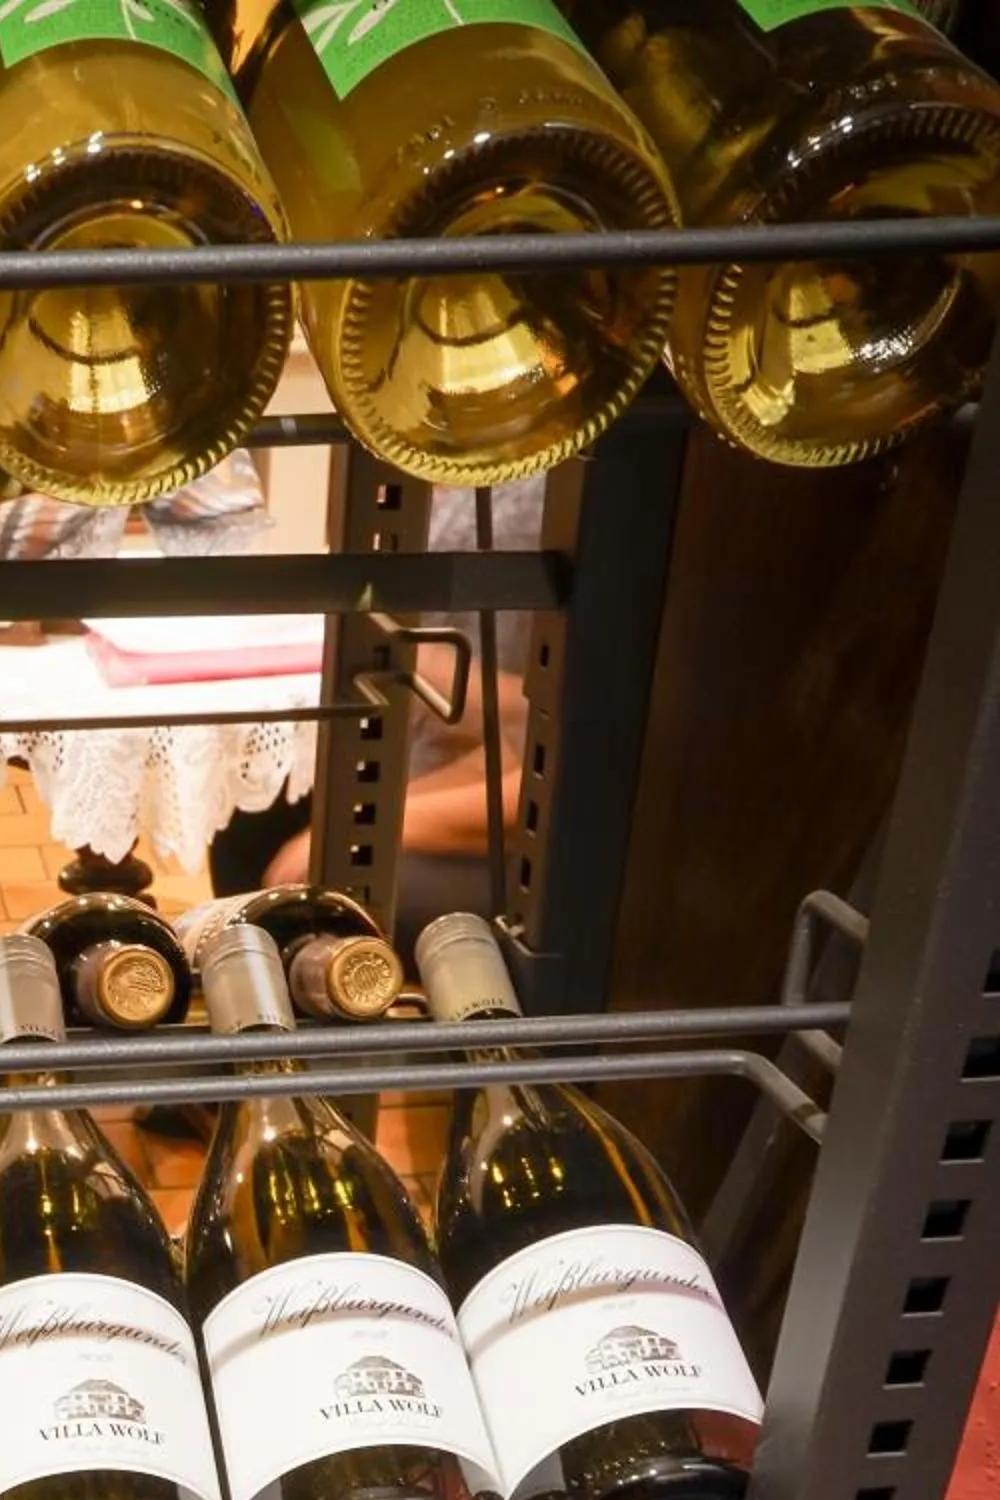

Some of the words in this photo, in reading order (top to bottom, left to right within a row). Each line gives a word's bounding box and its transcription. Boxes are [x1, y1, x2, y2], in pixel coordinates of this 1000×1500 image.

[574, 1365, 640, 1397] VILLA
[642, 1363, 702, 1379] WOLF
[318, 1398, 384, 1421] VILLA
[387, 1398, 442, 1420] WOLF
[38, 1422, 103, 1441] VILLA
[107, 1422, 164, 1446] WOLF
